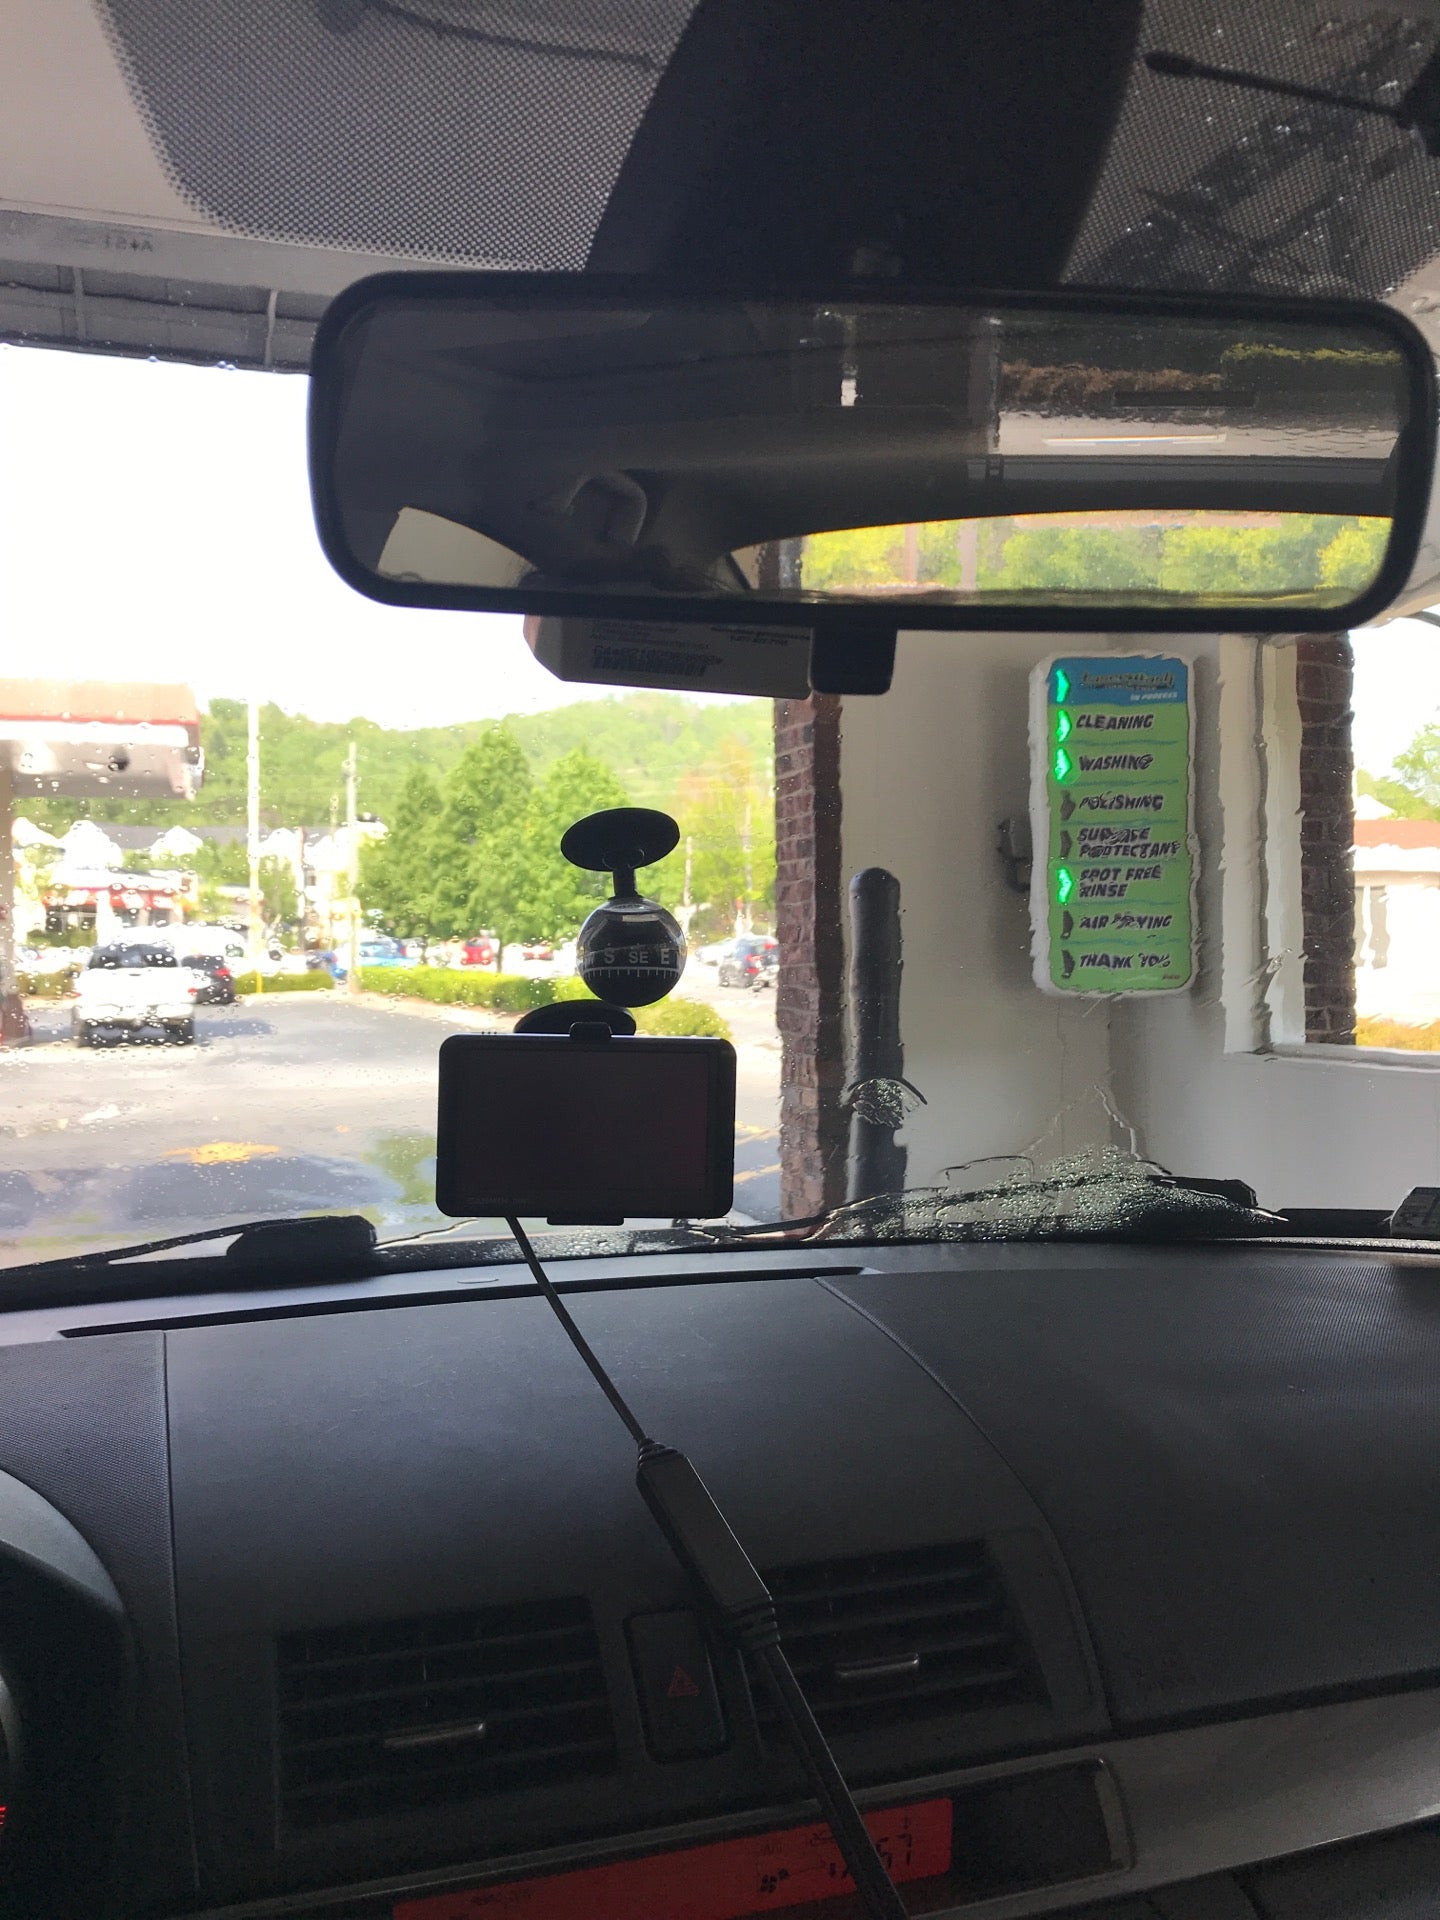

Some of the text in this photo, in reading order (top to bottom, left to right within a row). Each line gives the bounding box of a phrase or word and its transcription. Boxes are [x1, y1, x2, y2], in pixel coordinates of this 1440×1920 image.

[1076, 714, 1154, 730] CLEANING
[1079, 754, 1154, 771] WASHING
[1077, 827, 1150, 844] SURACE
[1080, 864, 1162, 881] SPOT FREE
[1079, 883, 1128, 898] RINSE
[1079, 915, 1109, 929] AIR
[603, 947, 616, 964] S
[628, 950, 649, 964] SE
[660, 948, 670, 965] E
[1080, 953, 1134, 969] THANK
